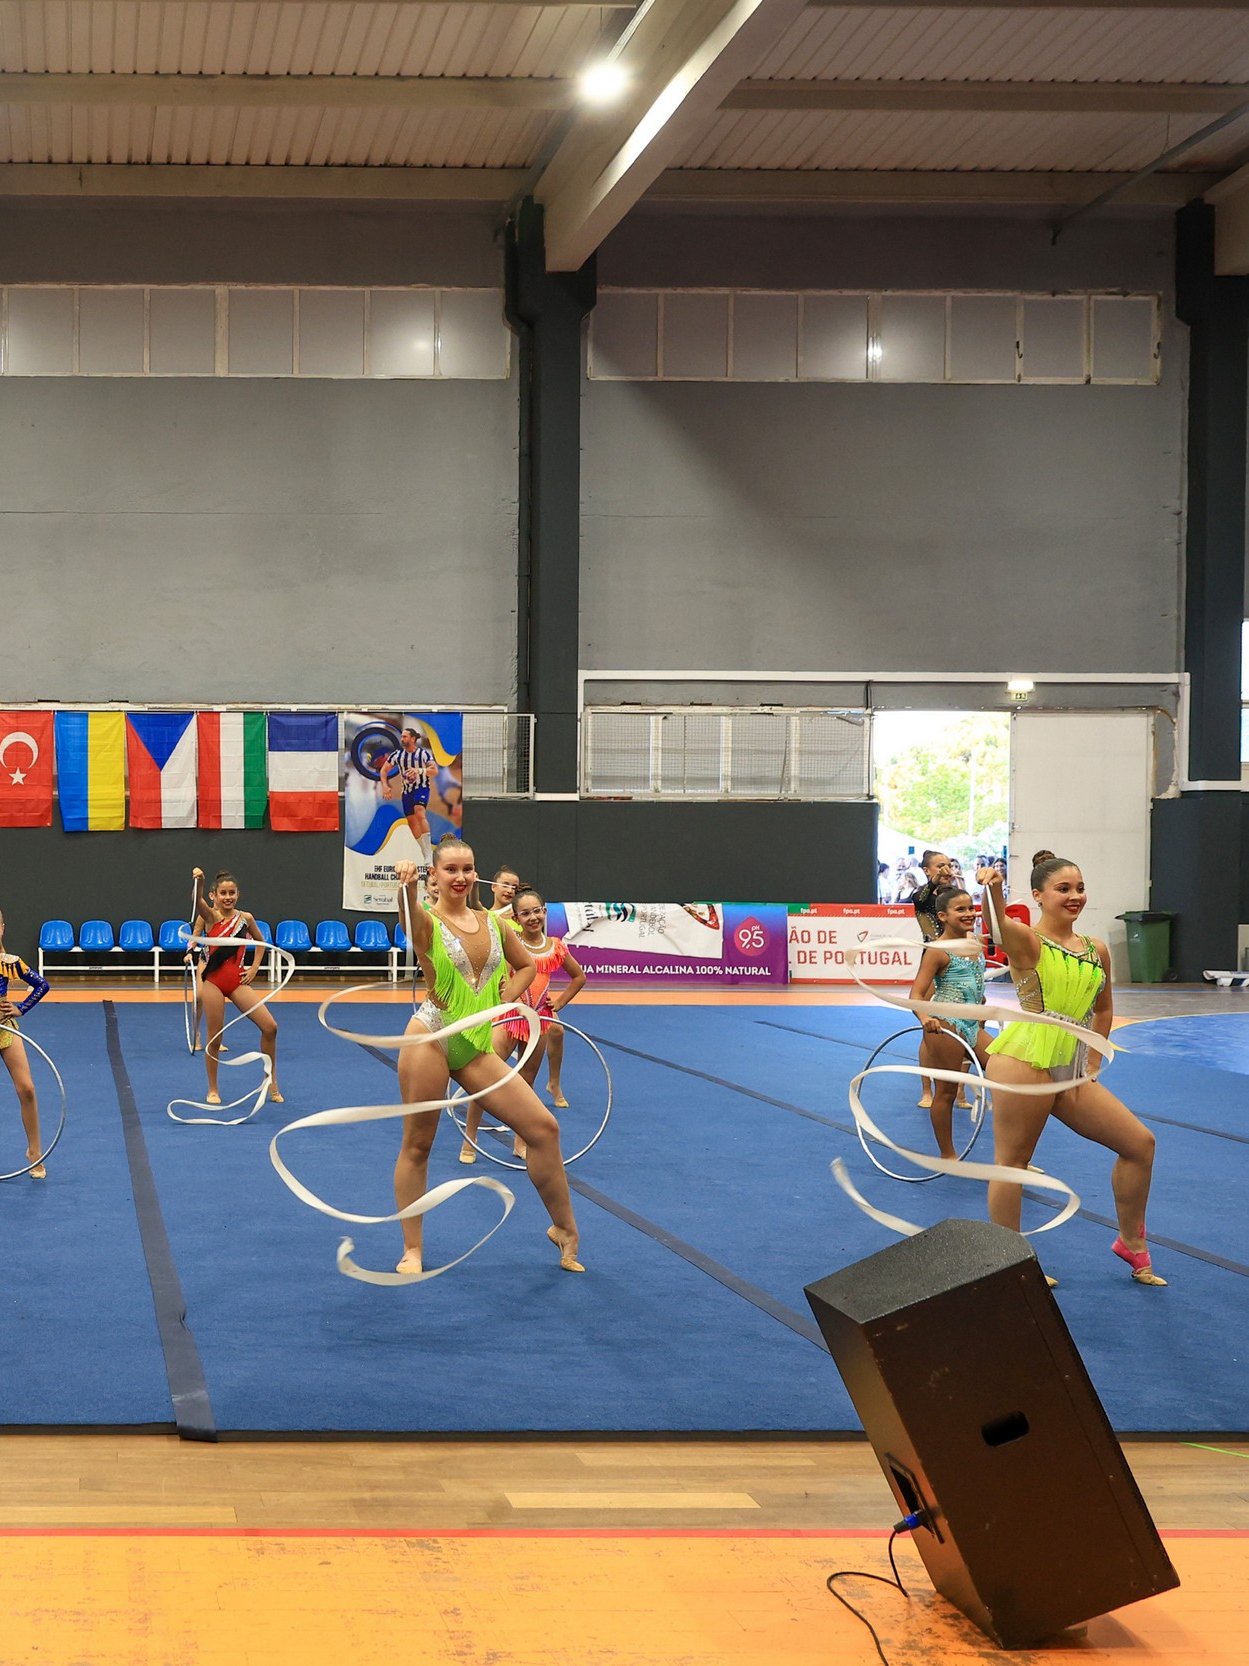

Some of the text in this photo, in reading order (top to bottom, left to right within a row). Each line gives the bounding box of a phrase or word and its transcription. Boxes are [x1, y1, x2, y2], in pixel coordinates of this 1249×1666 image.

[365, 873, 389, 881] HANDBALL
[817, 930, 837, 944] DE
[797, 950, 912, 965] DE POTUGAL
[596, 965, 641, 974] MINERAL
[643, 965, 694, 975] ALCALINA
[696, 965, 723, 975] 100%
[725, 965, 771, 976] NATURAL
